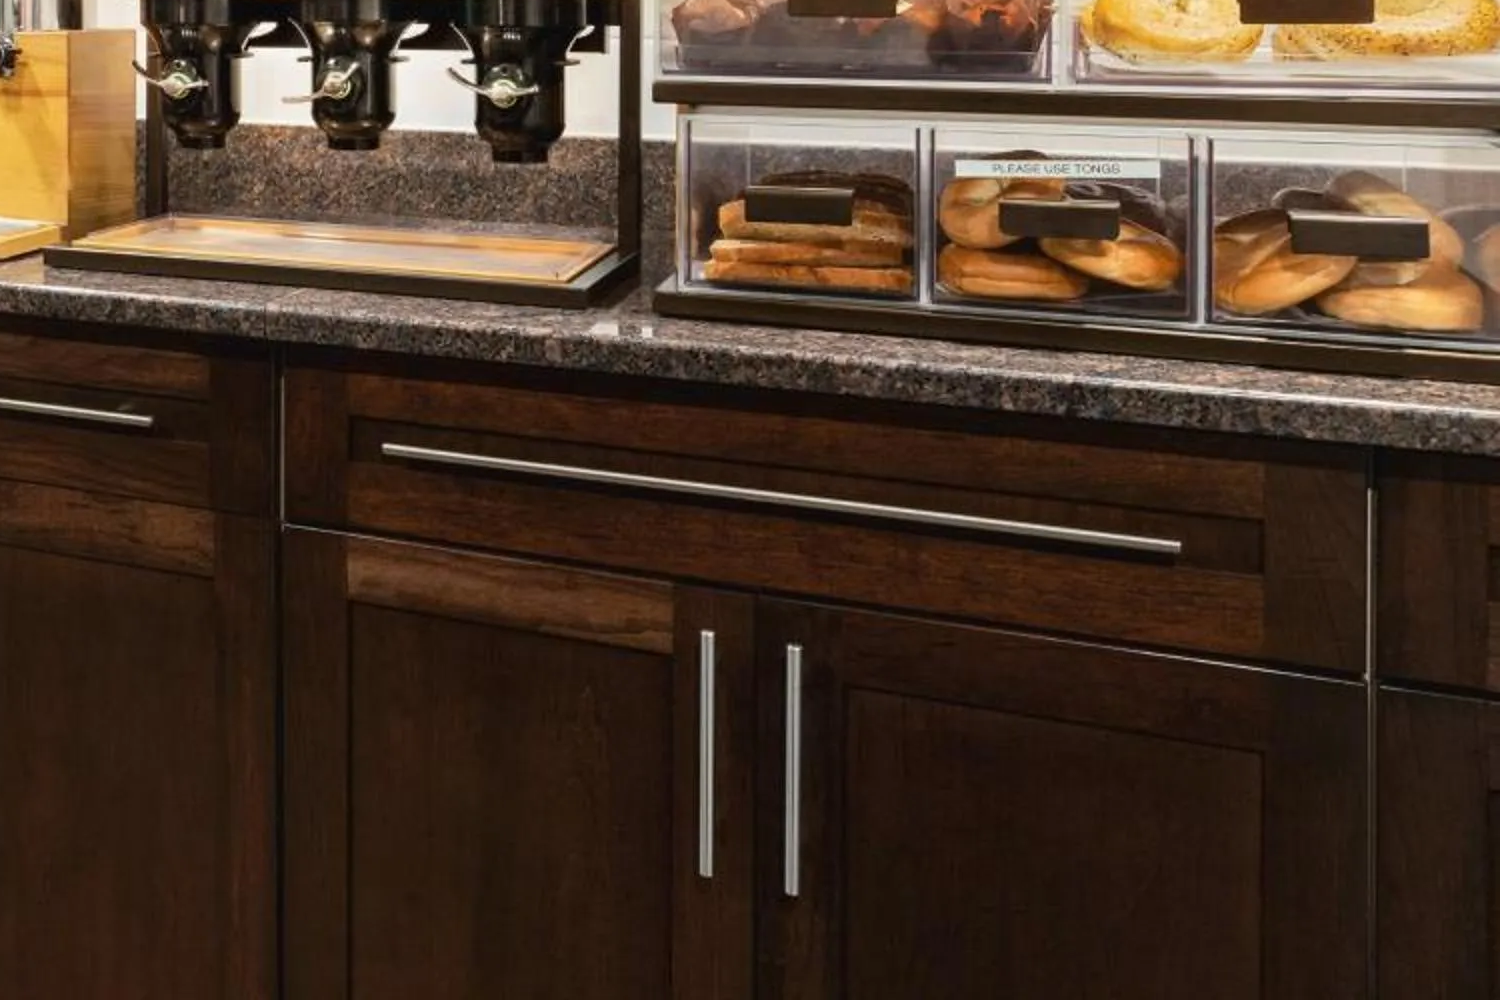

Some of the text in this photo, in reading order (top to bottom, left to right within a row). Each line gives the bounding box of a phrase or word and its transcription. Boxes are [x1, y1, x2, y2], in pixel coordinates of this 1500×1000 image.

[992, 163, 1121, 174] PLEASE USE TONGS
